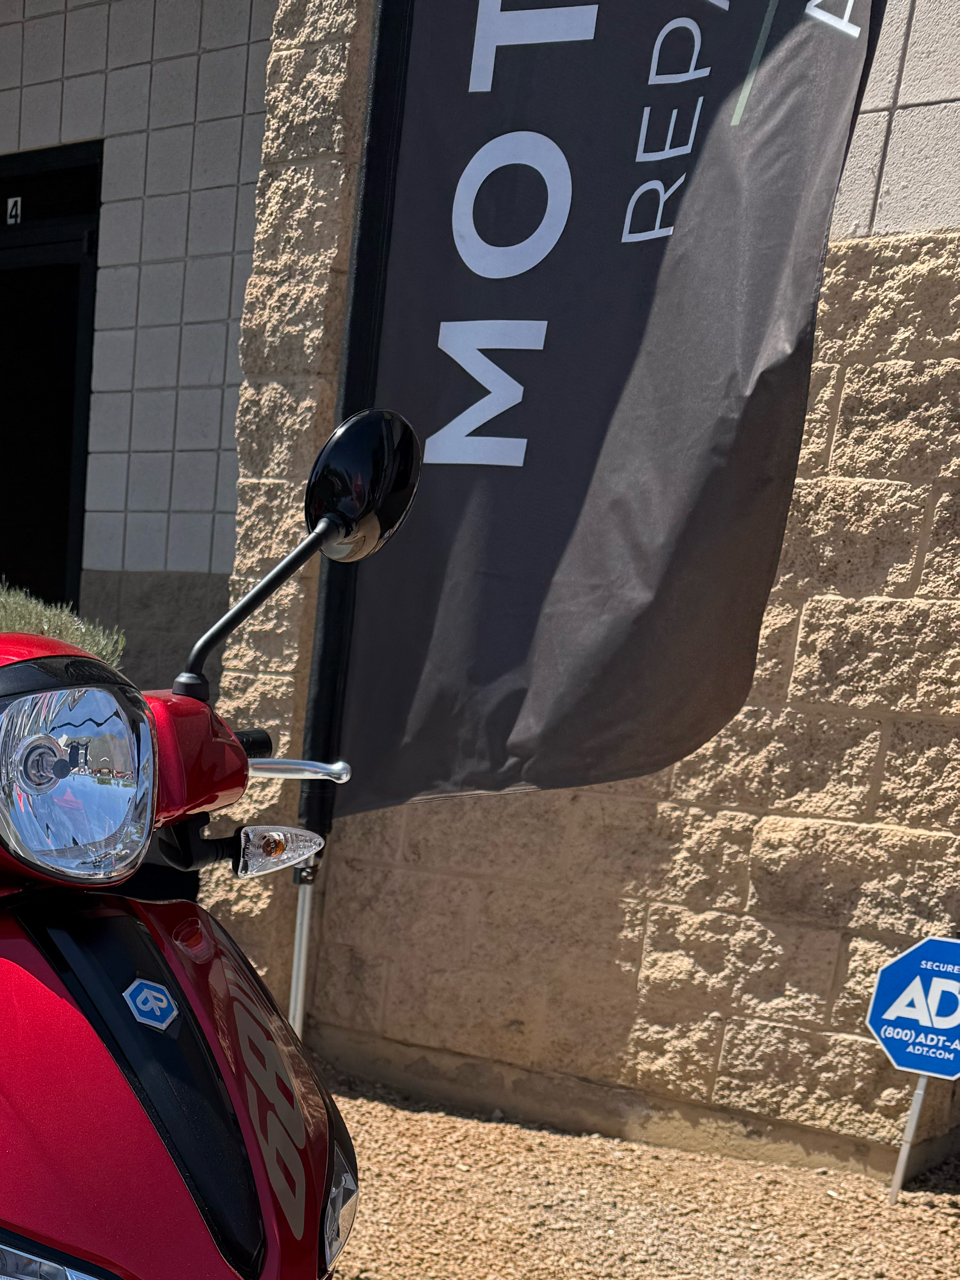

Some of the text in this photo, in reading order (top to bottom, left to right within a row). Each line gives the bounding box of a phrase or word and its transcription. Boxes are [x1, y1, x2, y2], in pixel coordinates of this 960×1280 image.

[622, 0, 730, 243] REP
[8, 199, 20, 224] 4
[423, 0, 599, 467] MOT
[905, 1045, 955, 1061] ADT.COM
